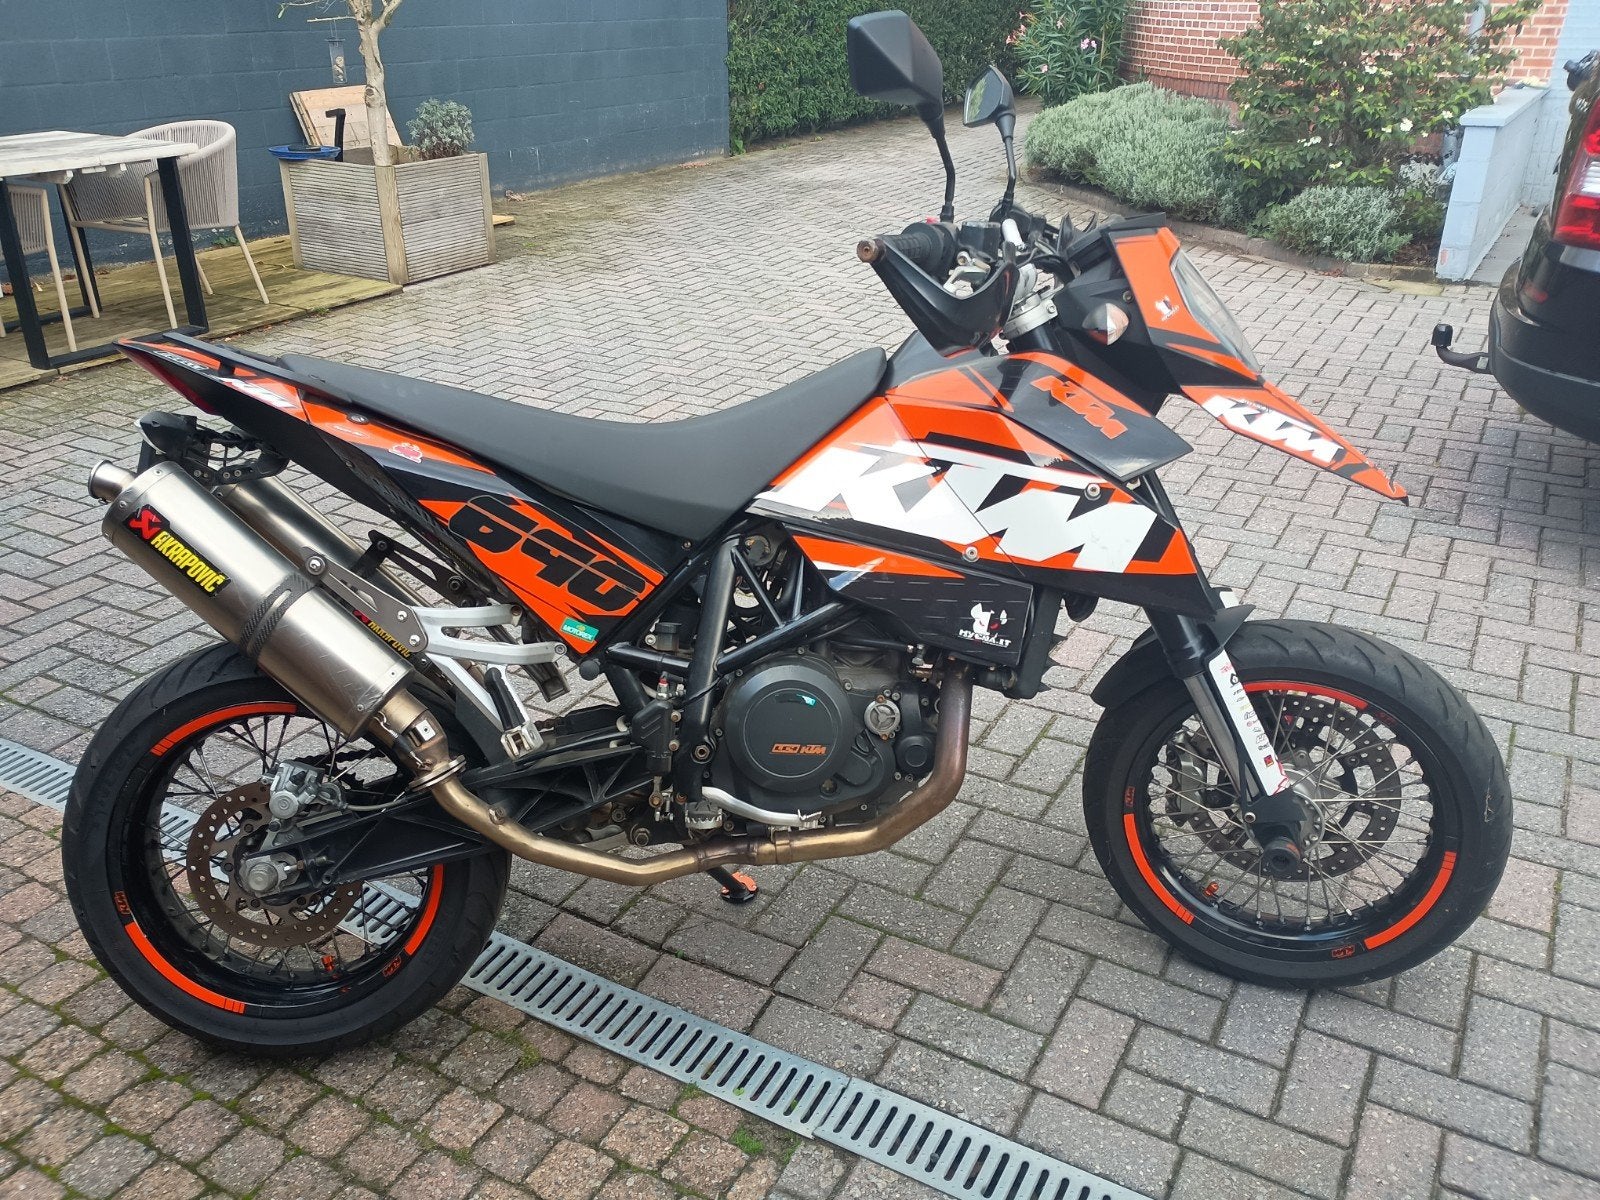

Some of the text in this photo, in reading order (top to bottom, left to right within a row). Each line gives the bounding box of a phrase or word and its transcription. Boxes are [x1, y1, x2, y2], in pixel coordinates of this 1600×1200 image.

[1030, 376, 1128, 439] KTM
[1201, 395, 1344, 463] KTM
[756, 440, 1157, 574] KTM
[449, 495, 646, 611] 690
[562, 624, 593, 641] MOTOREX
[800, 744, 826, 755] KTM
